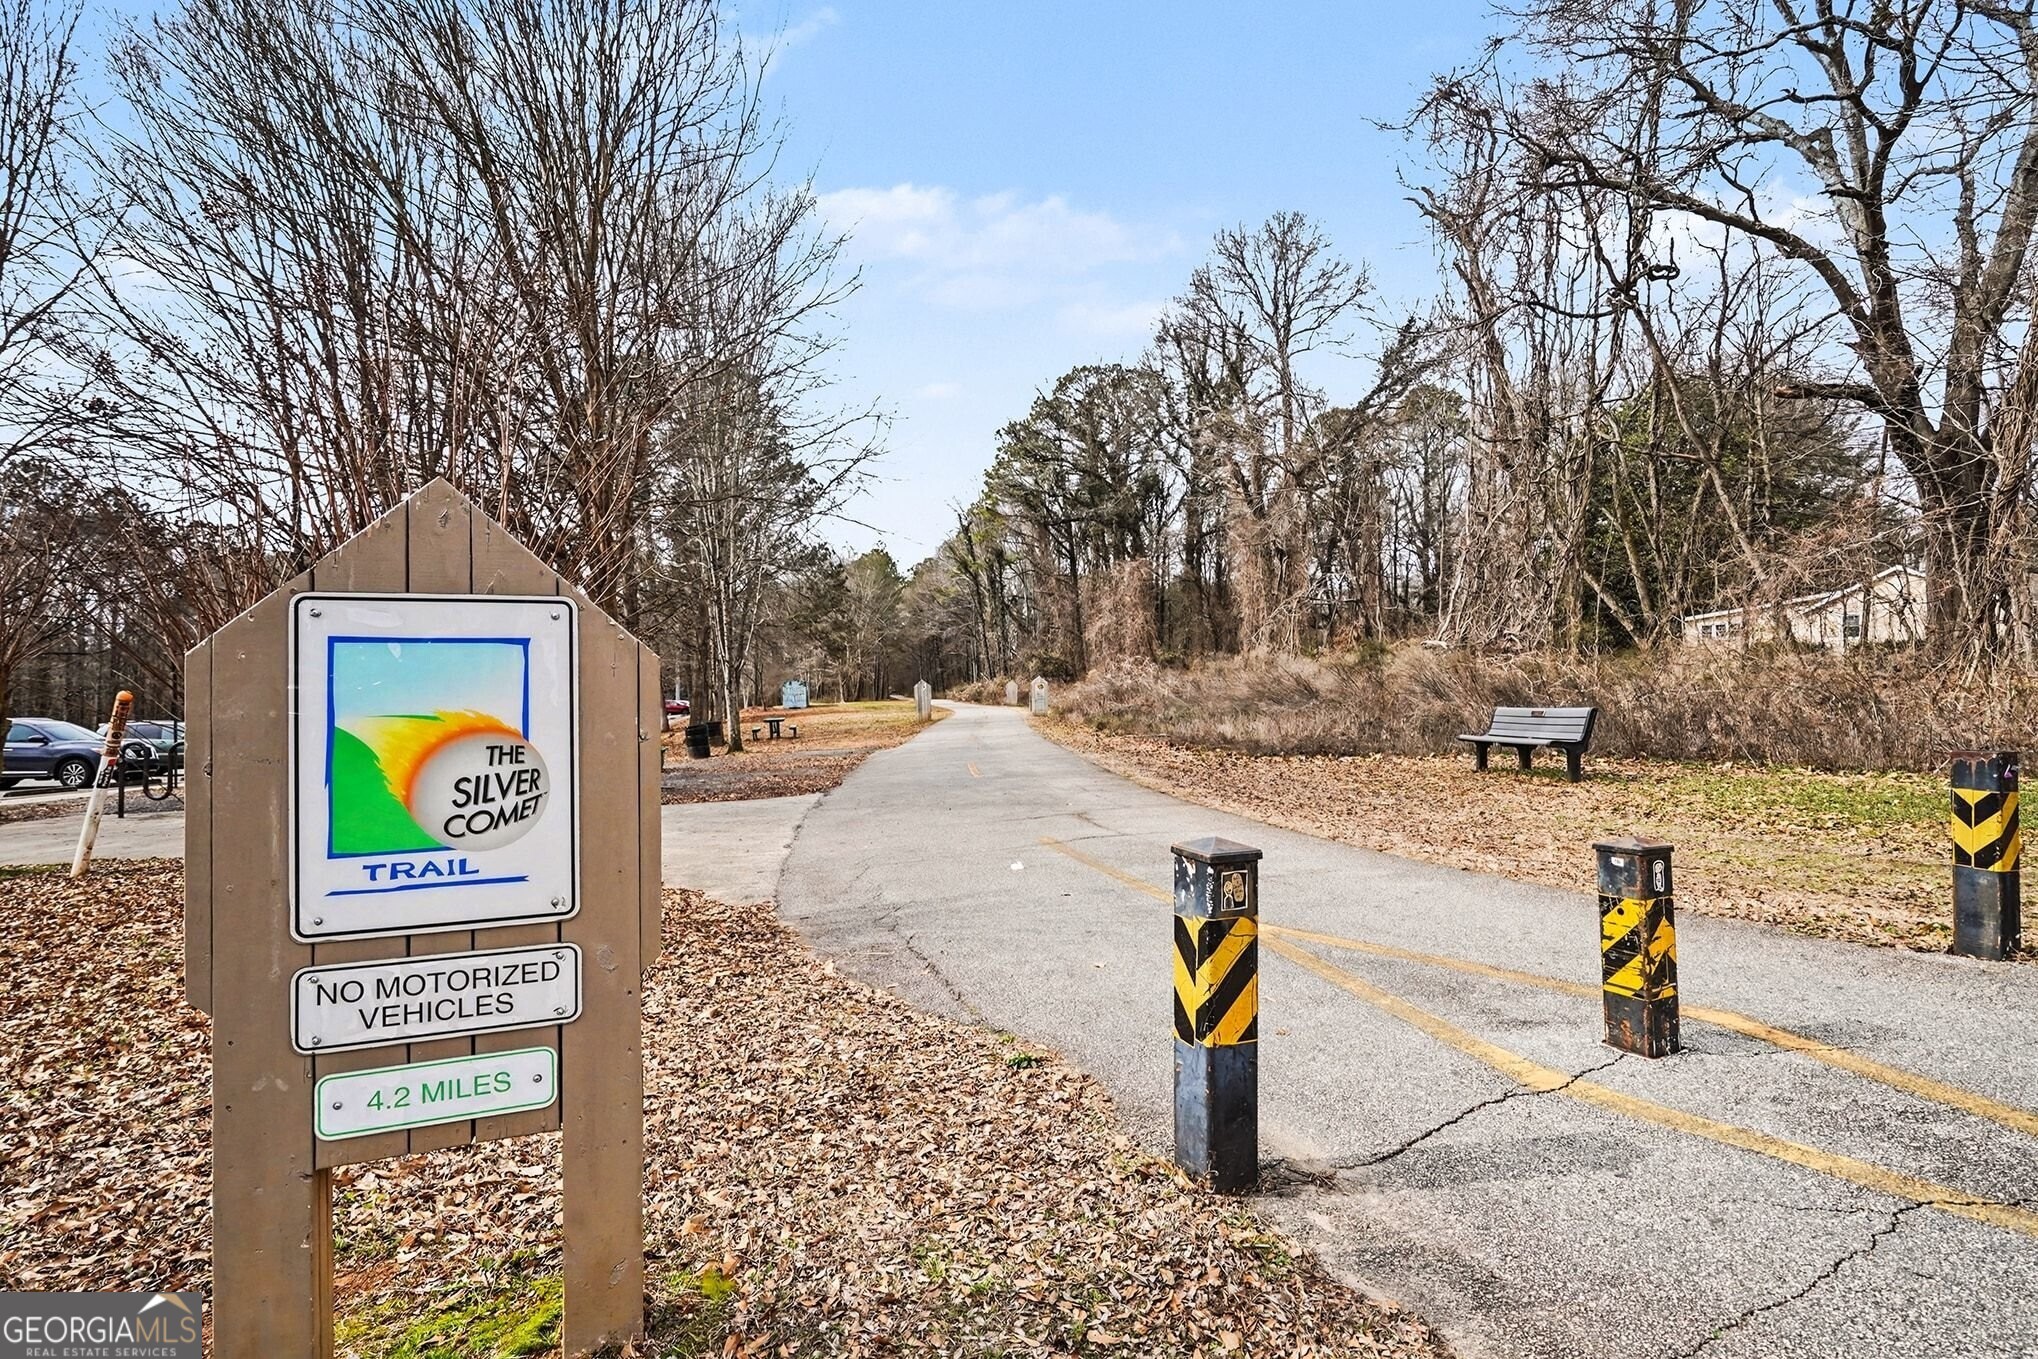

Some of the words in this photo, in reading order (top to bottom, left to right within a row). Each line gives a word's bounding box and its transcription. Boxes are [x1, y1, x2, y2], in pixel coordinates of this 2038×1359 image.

[486, 745, 525, 767] THE
[452, 768, 541, 809] SILVER
[362, 858, 480, 882] TRAIL
[316, 981, 364, 1006] NO
[376, 961, 560, 1000] MOTORIZED
[358, 992, 514, 1030] VEHICLES
[367, 1087, 411, 1111] 4.2
[421, 1071, 512, 1104] MILES
